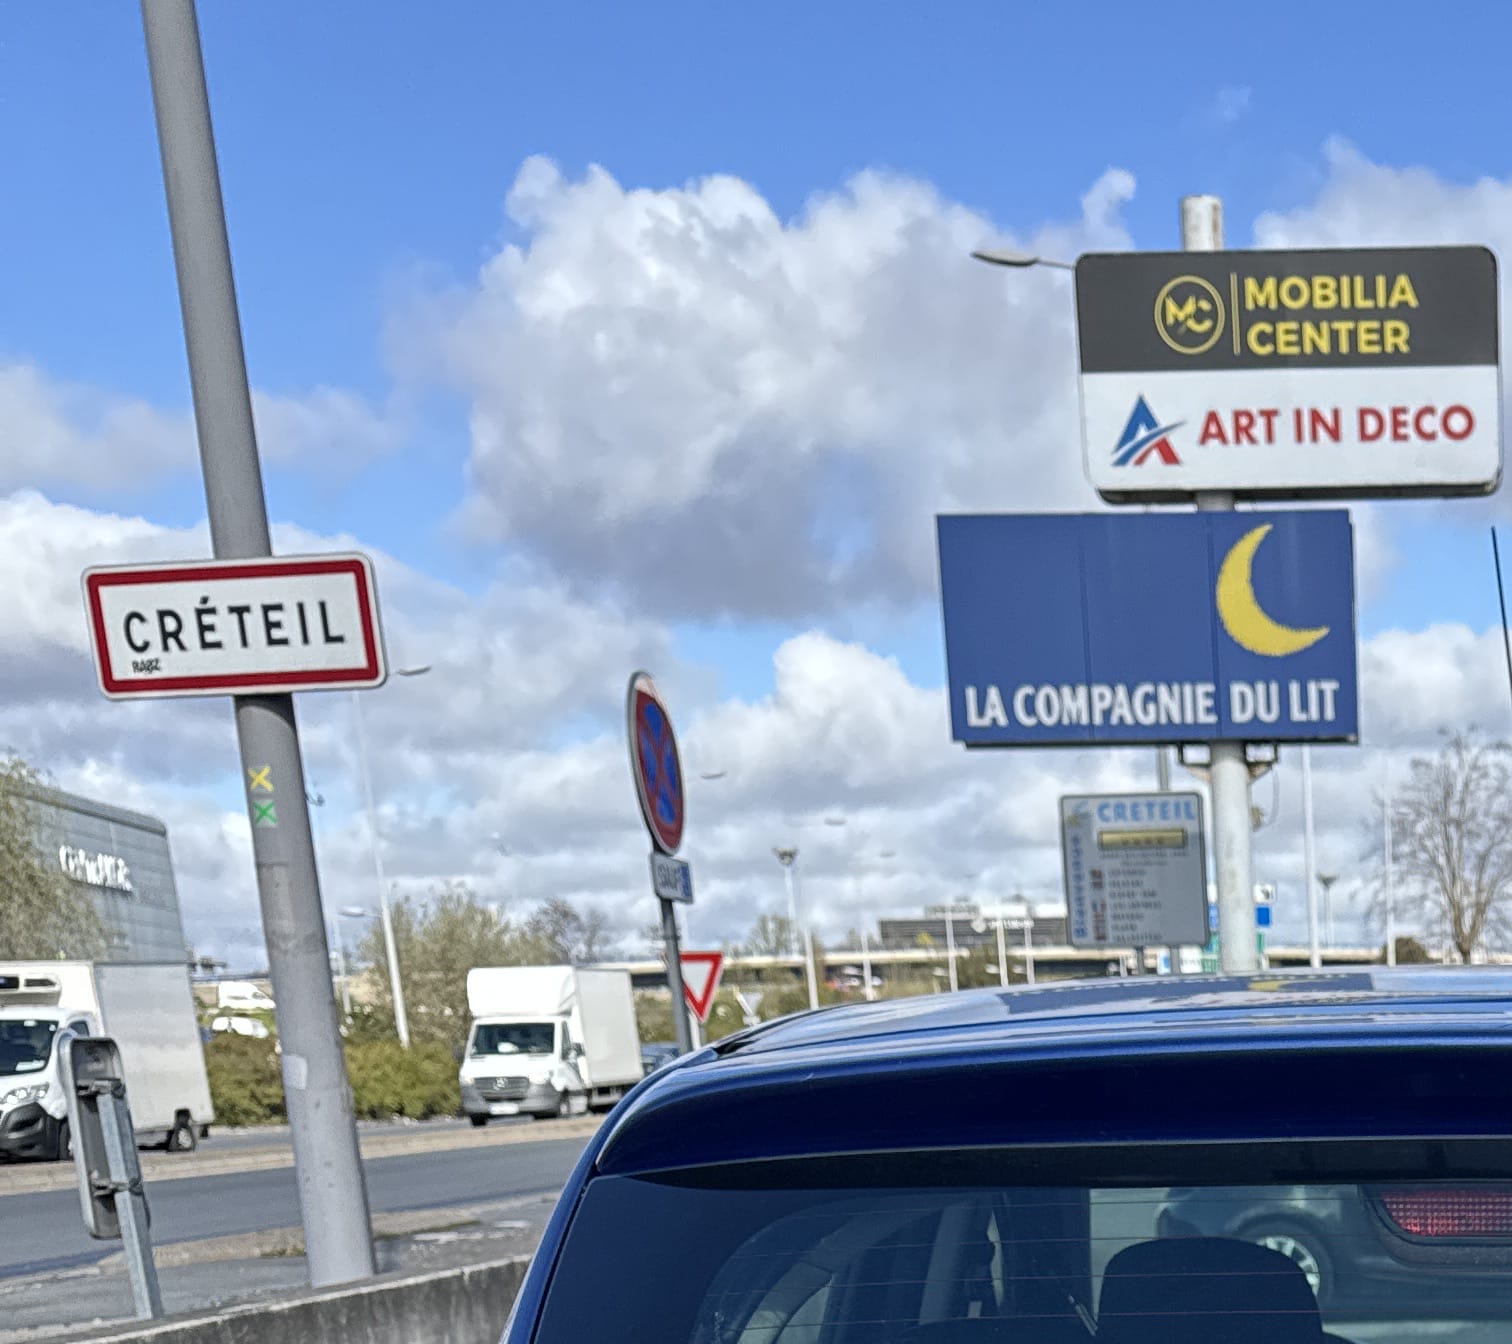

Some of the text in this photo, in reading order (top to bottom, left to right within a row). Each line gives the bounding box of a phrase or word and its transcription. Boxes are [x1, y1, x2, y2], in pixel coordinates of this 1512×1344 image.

[1244, 273, 1419, 310] MOBILIA
[1246, 319, 1411, 356] CENTER
[1199, 403, 1476, 446] ART IN DECO
[123, 596, 345, 654] CRÉTEIL
[964, 680, 1340, 728] LA COMPAGNIE DU LIT
[1097, 800, 1195, 823] CRETEIL
